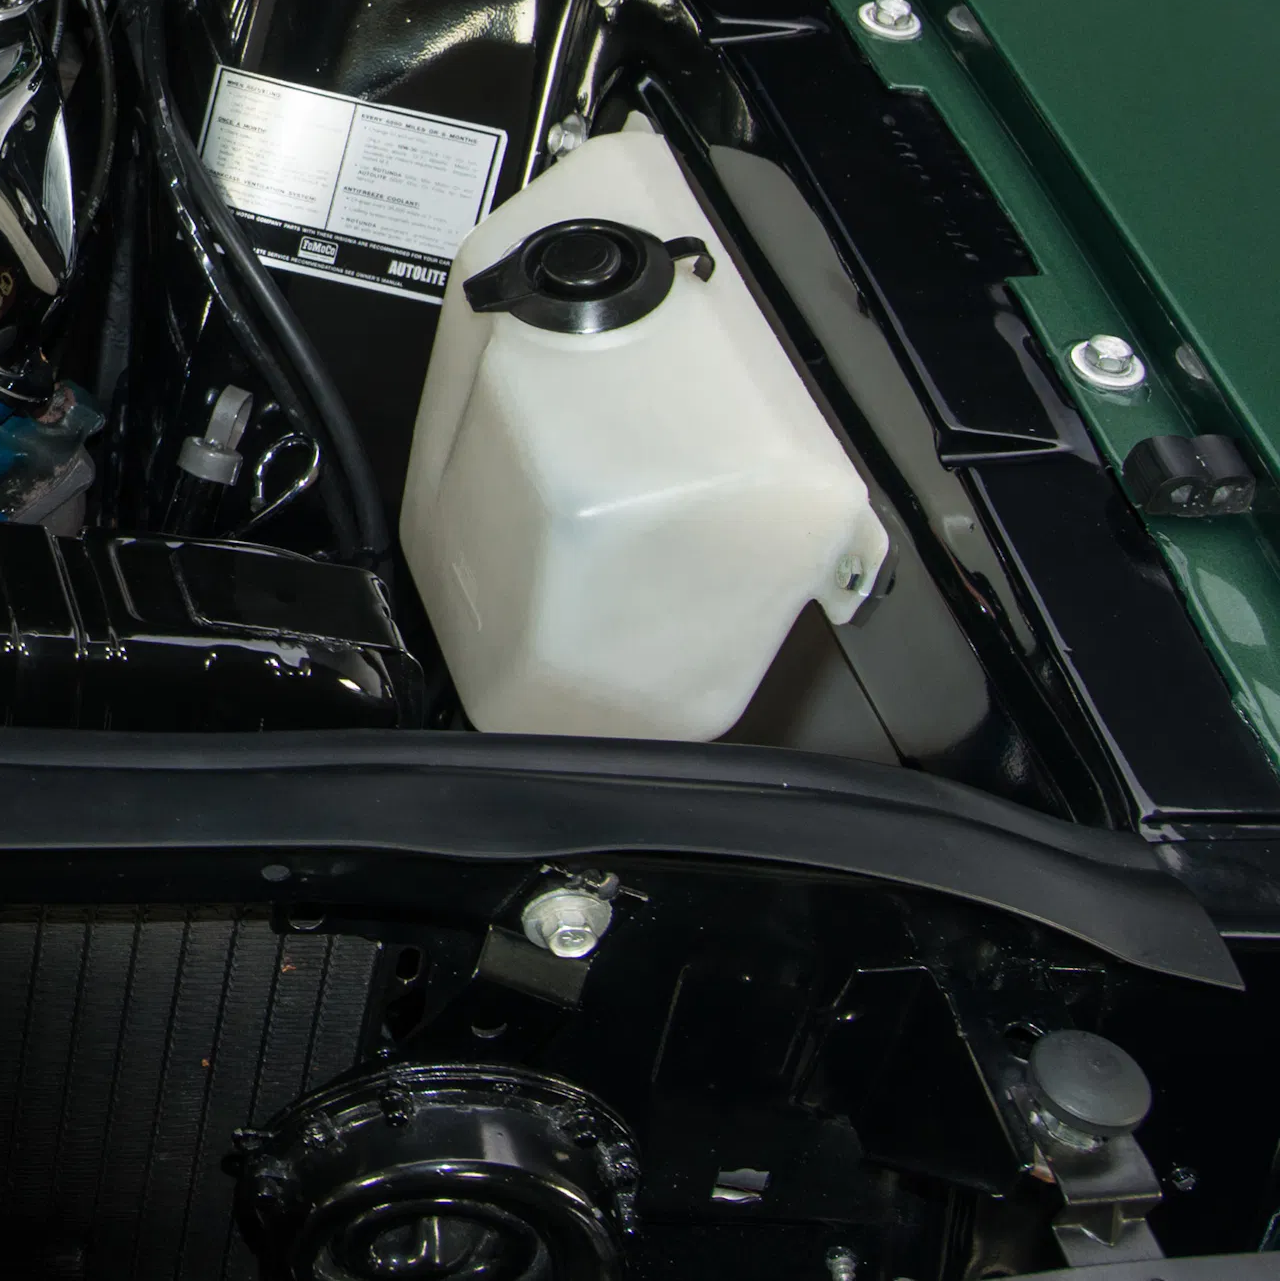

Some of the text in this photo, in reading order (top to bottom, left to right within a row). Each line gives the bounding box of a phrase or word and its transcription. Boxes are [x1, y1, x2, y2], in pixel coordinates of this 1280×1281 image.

[234, 210, 255, 221] MOTOR
[255, 215, 283, 228] COMPANY
[282, 222, 301, 232] PARTS
[300, 226, 316, 235] WITH
[315, 229, 334, 240] THESE
[356, 239, 368, 248] ARE
[367, 241, 410, 258] RECOMMENDED
[410, 251, 422, 260] FOR
[422, 254, 438, 264] YOUR
[300, 238, 337, 257] FoMoCo
[266, 249, 290, 261] SERVICE
[289, 254, 343, 274] RECOMMENDATIONS
[343, 268, 355, 276] SEE
[386, 257, 448, 288] AUTOLITE
